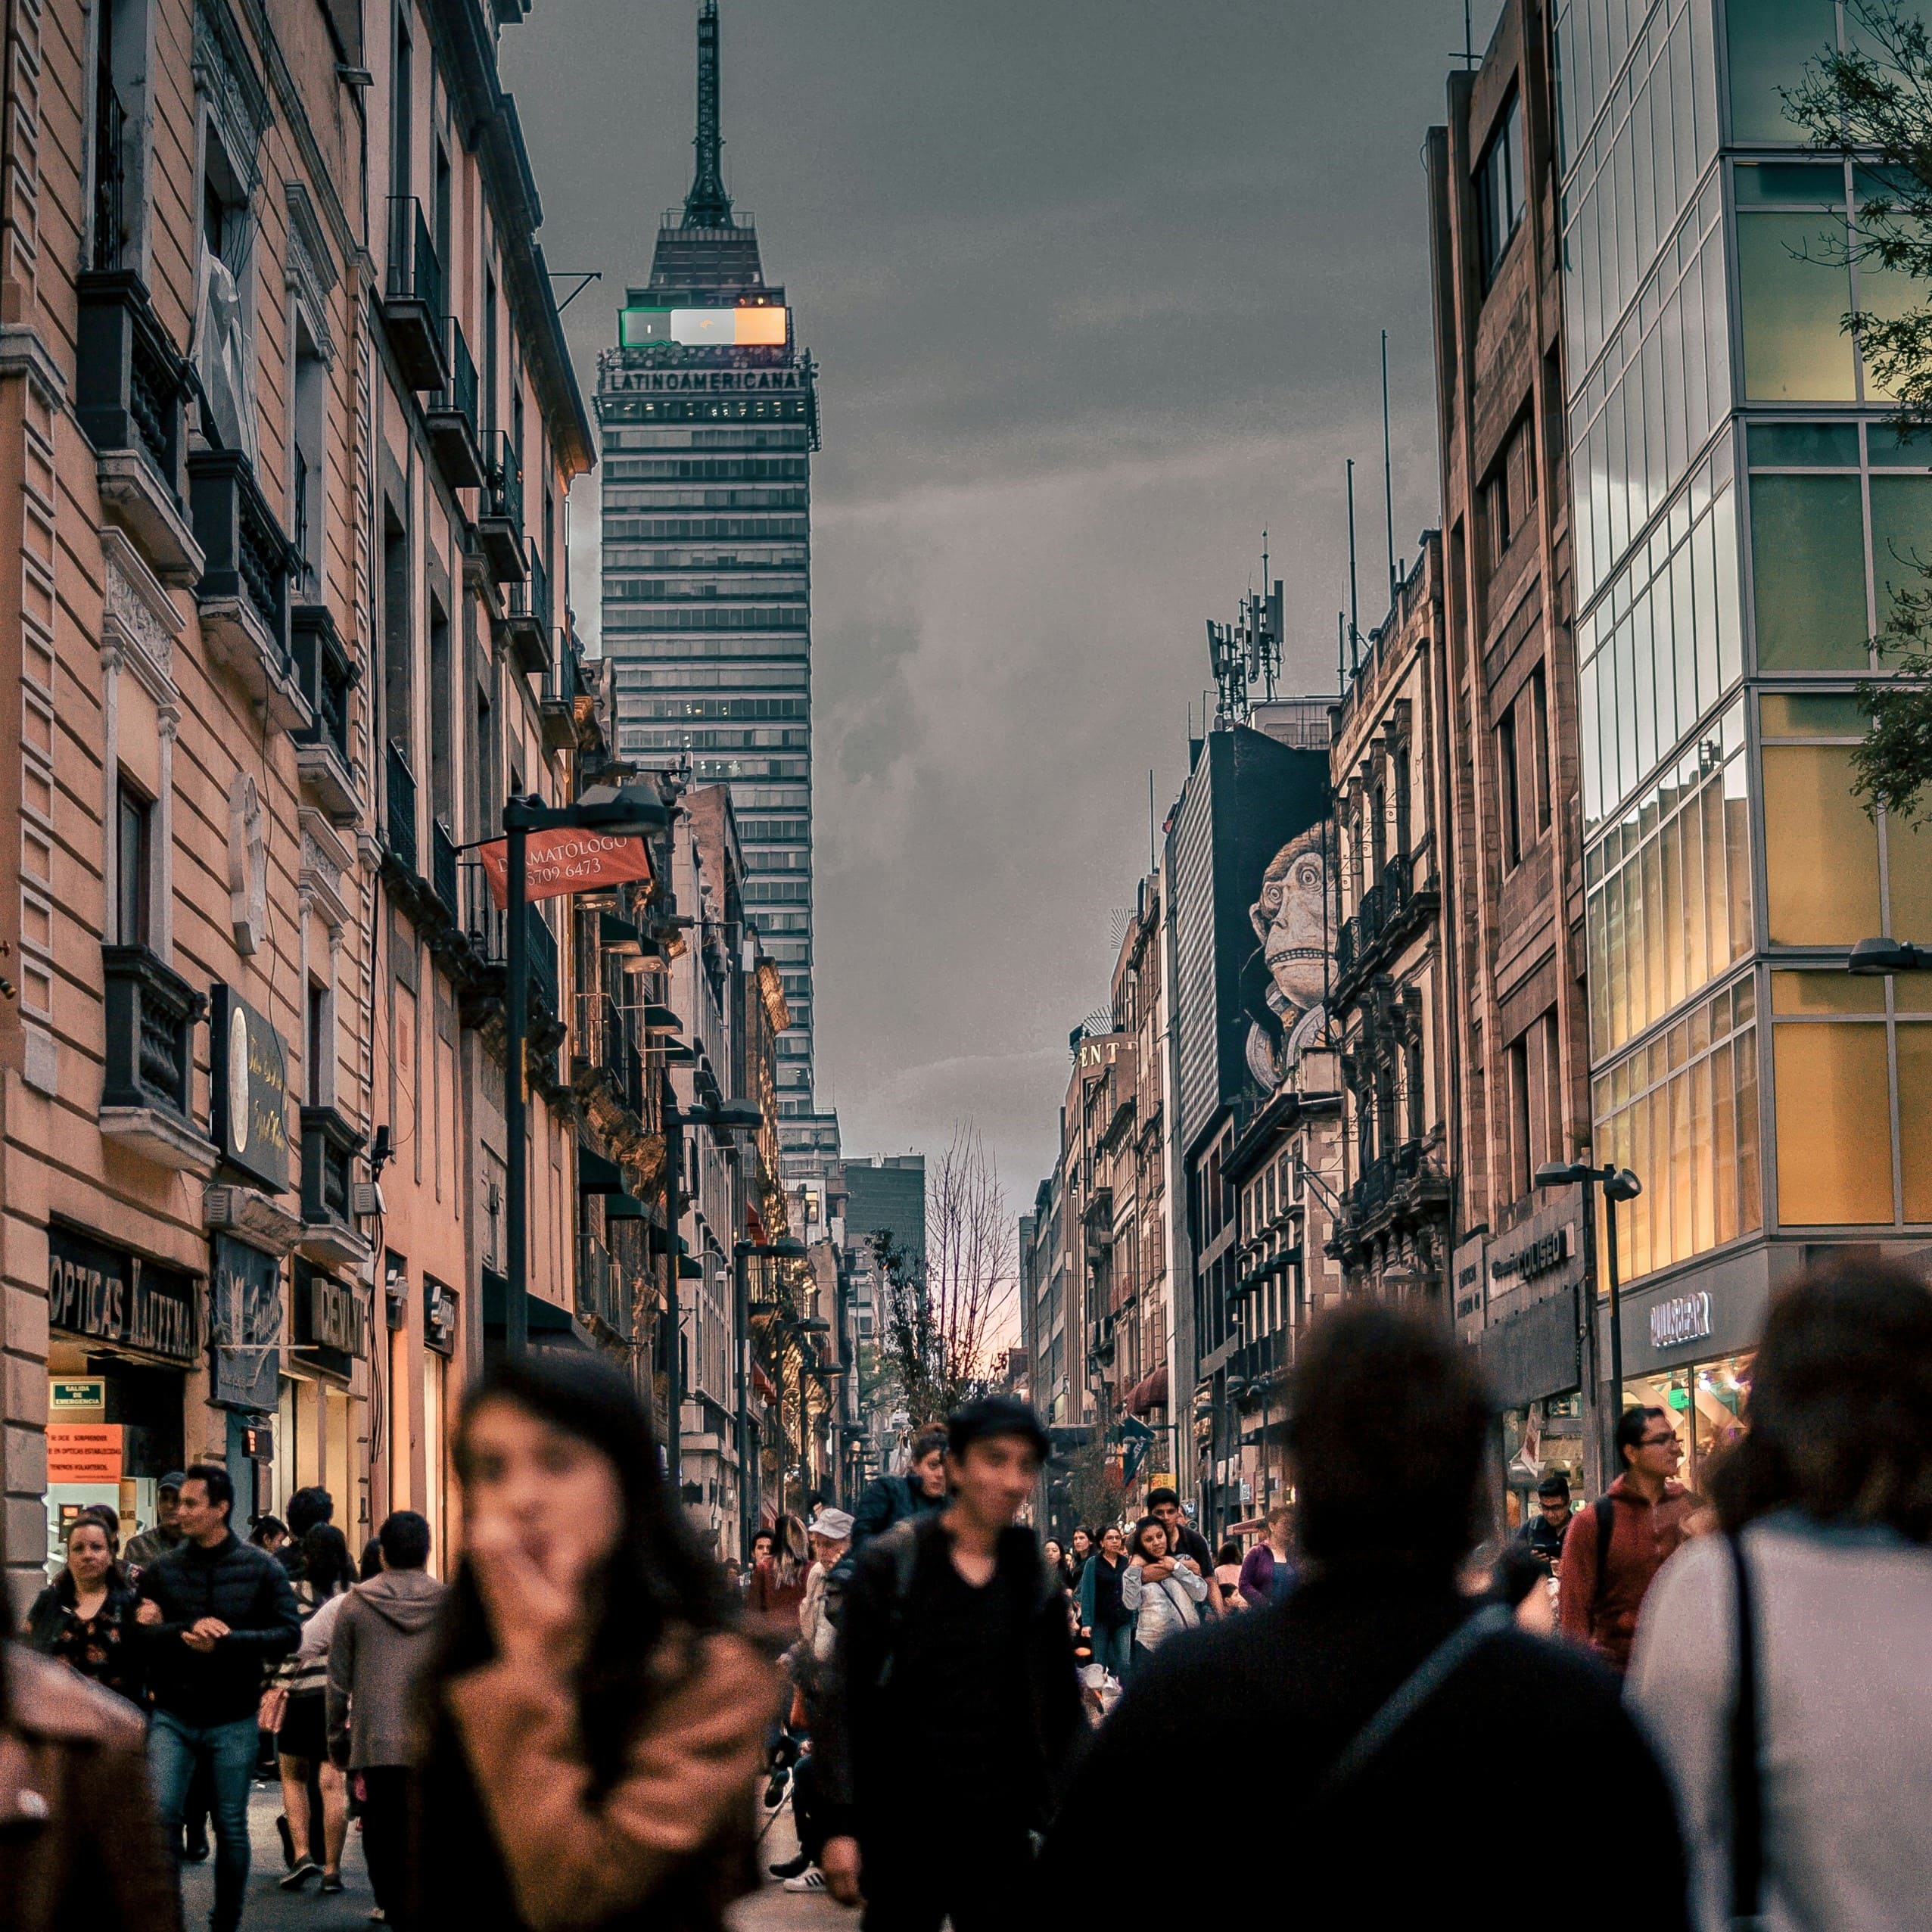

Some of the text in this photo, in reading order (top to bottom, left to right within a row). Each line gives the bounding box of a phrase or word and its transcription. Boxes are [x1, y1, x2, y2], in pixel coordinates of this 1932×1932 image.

[610, 372, 796, 390] LATINOAMERICANA
[497, 835, 628, 873] DMATÓLOGO
[527, 857, 602, 886] 5709 6473
[49, 1255, 123, 1339] OPTICAS
